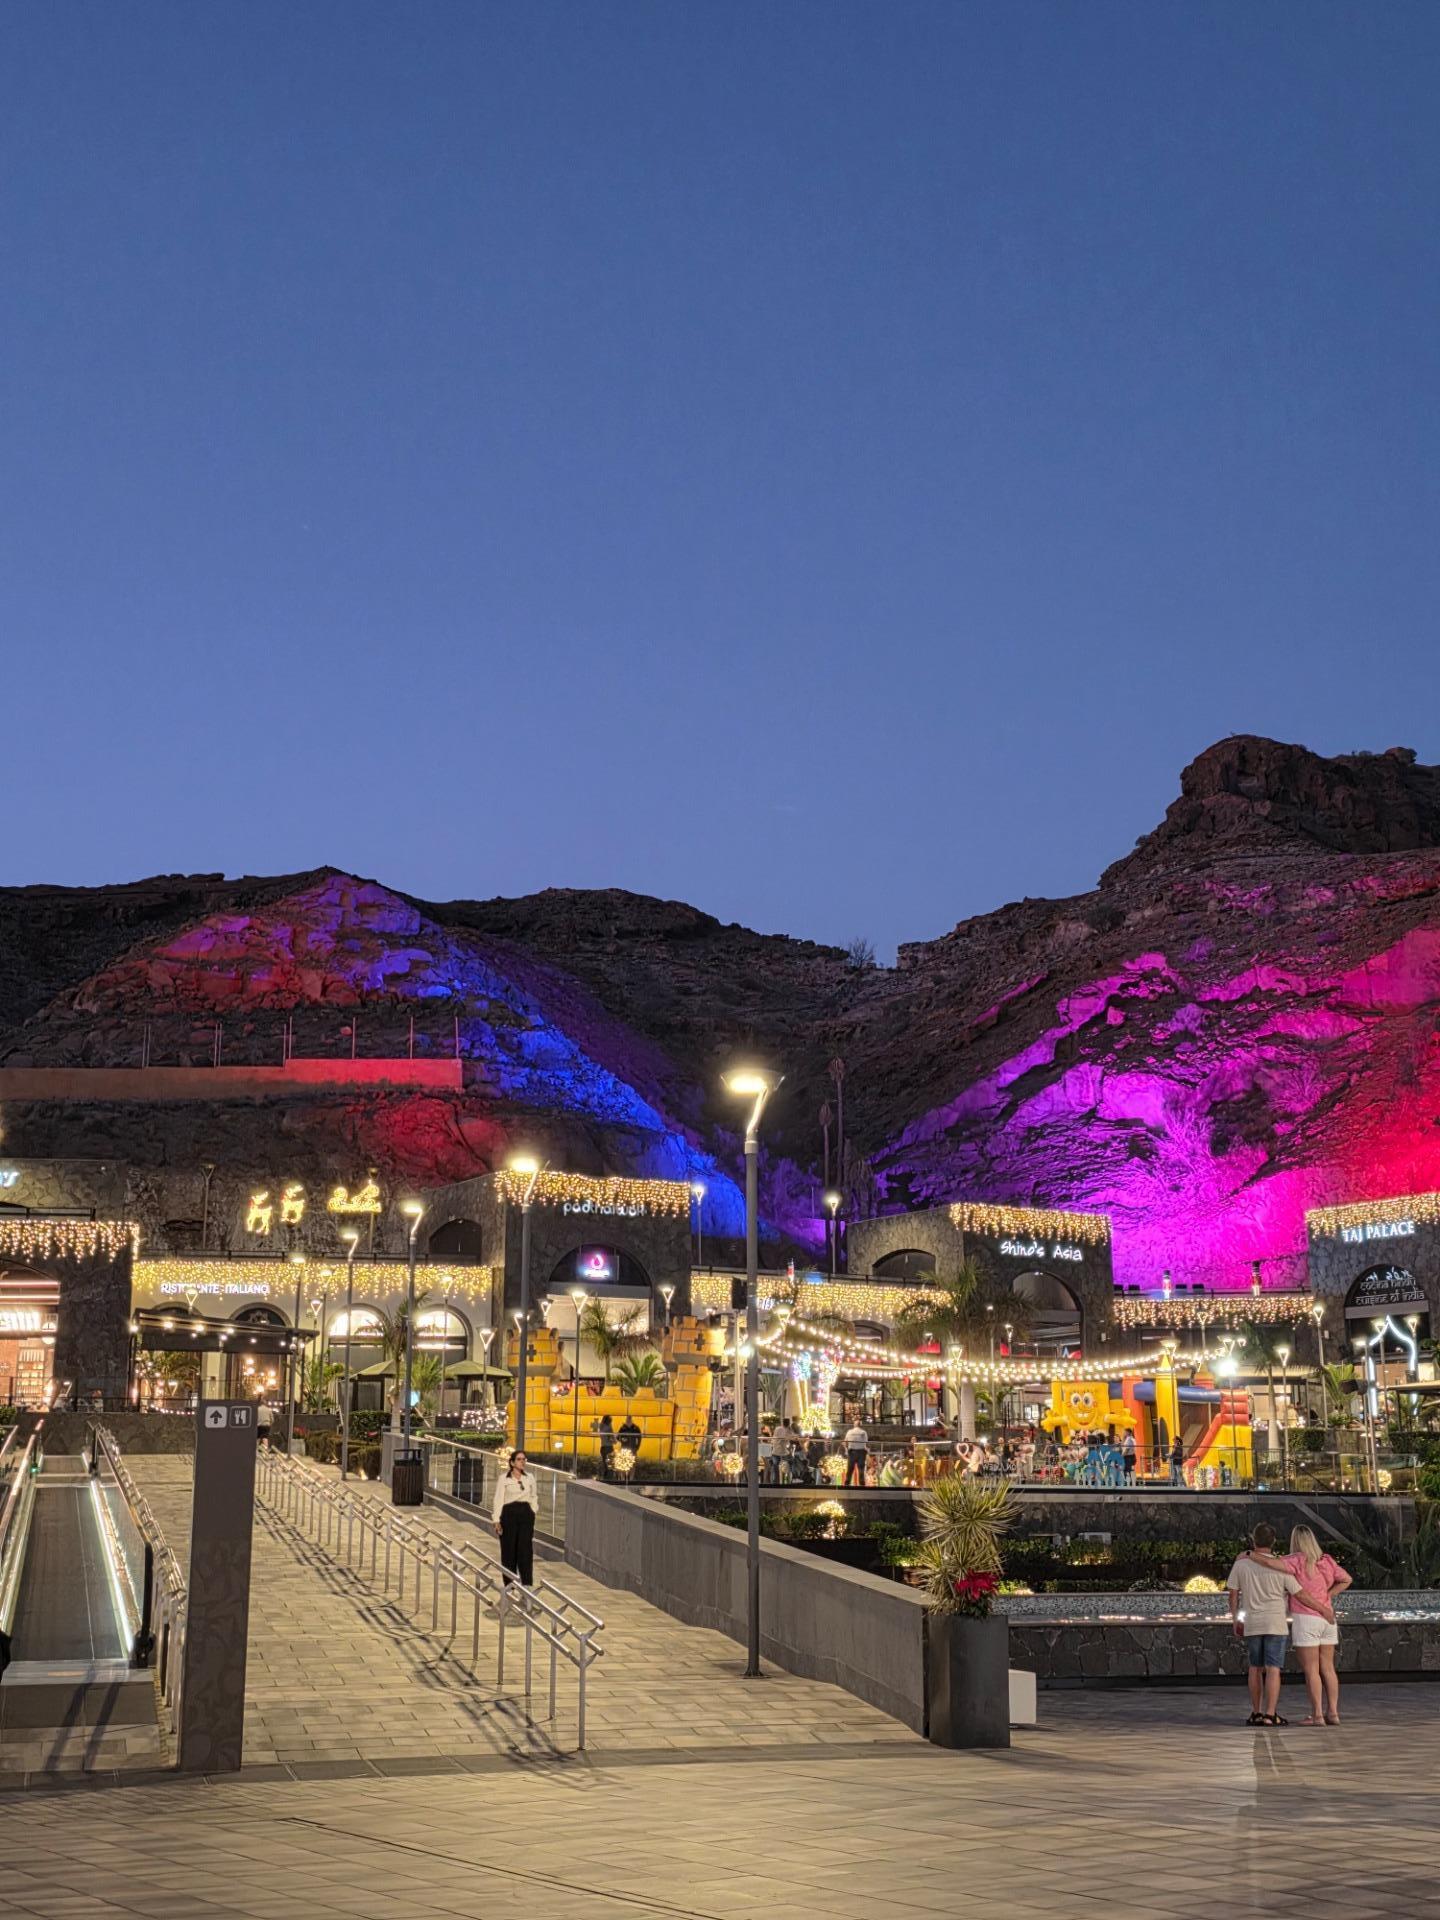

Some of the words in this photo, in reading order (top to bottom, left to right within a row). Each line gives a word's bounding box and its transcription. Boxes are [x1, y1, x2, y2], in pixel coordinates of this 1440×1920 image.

[1342, 1227, 1363, 1243] TAJ
[1366, 1221, 1414, 1239] PALACE
[1001, 1241, 1045, 1258] Shino's
[1053, 1245, 1082, 1261] Asia
[161, 1283, 219, 1294] RISTNTE
[225, 1283, 270, 1294] ITALIANO
